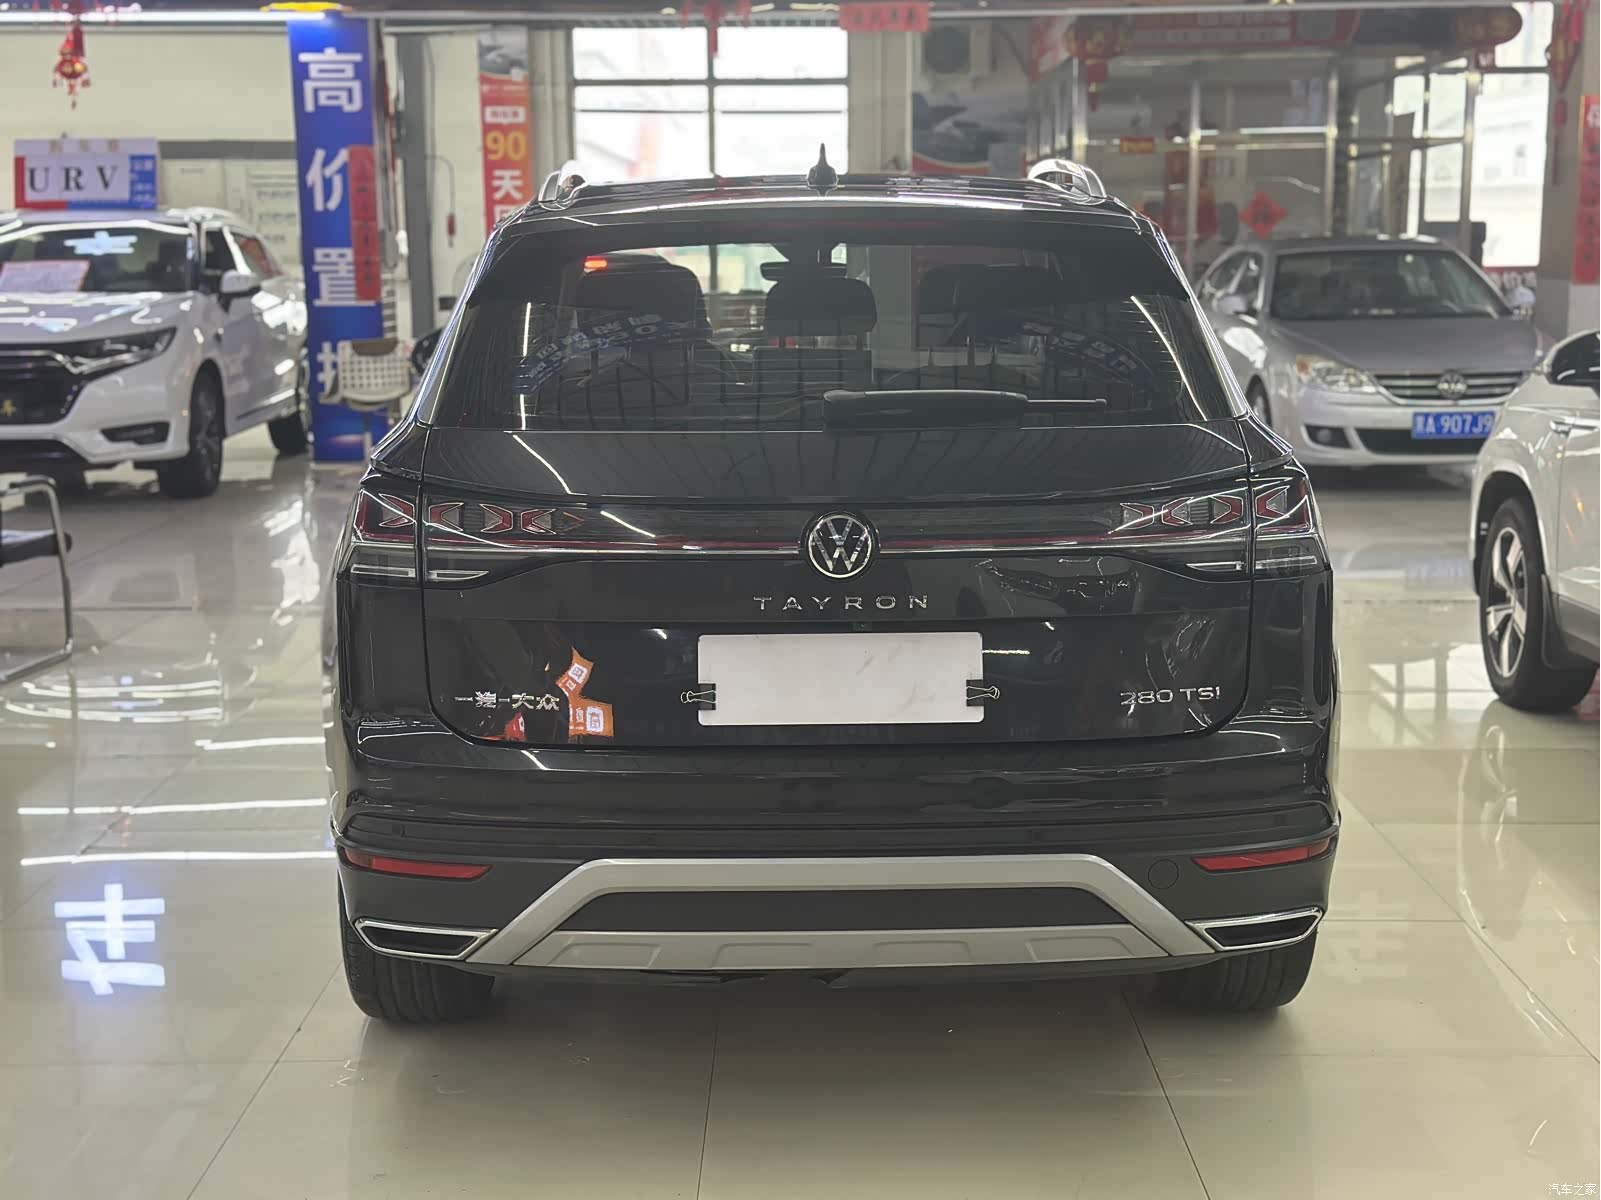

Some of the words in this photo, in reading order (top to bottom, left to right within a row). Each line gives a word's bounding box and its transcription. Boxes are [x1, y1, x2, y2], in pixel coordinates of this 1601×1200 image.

[485, 130, 528, 161] 90
[28, 165, 118, 192] URV
[753, 595, 929, 611] TAYRON
[1120, 689, 1174, 705] 280
[1179, 686, 1220, 701] TSI
